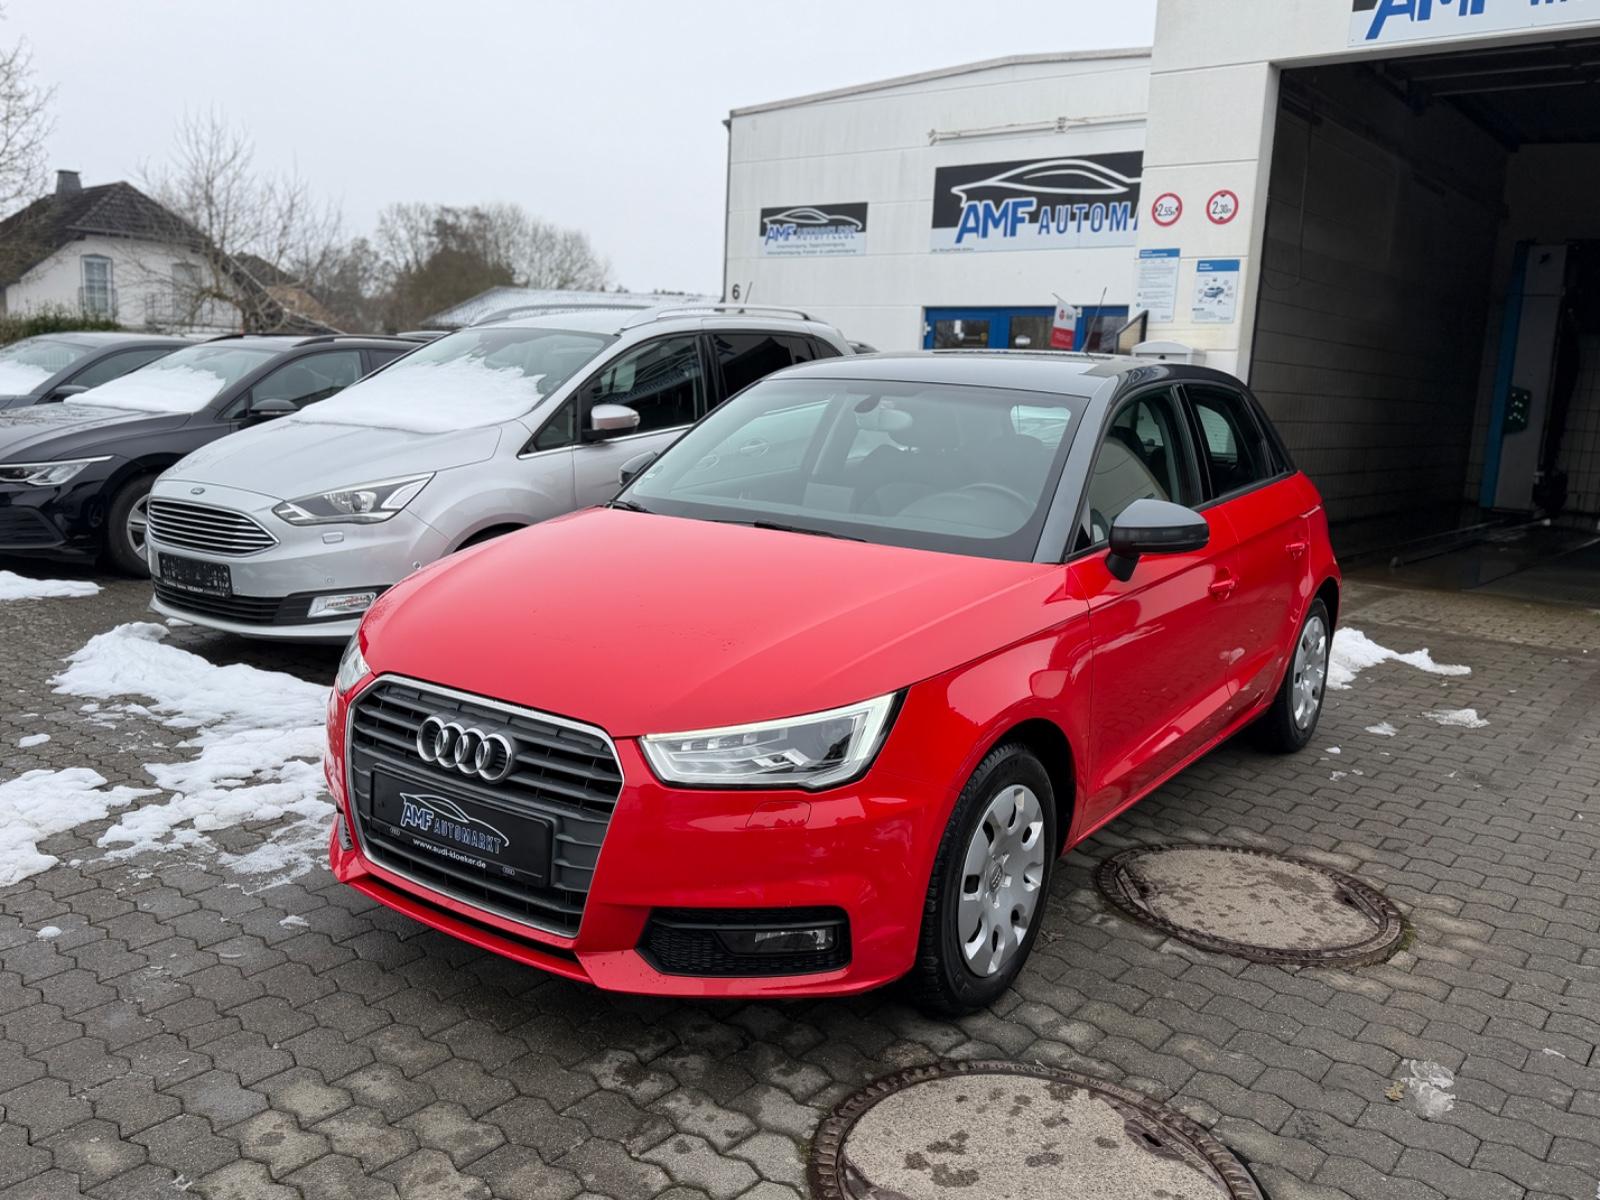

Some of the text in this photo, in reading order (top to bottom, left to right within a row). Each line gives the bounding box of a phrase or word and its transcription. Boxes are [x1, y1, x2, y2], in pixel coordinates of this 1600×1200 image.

[764, 224, 796, 246] AMF
[953, 198, 1036, 244] AMF
[732, 283, 741, 300] 6
[401, 802, 501, 854] AMF AUTOMARKT
[412, 838, 487, 869] www.audi-kloeker.de
